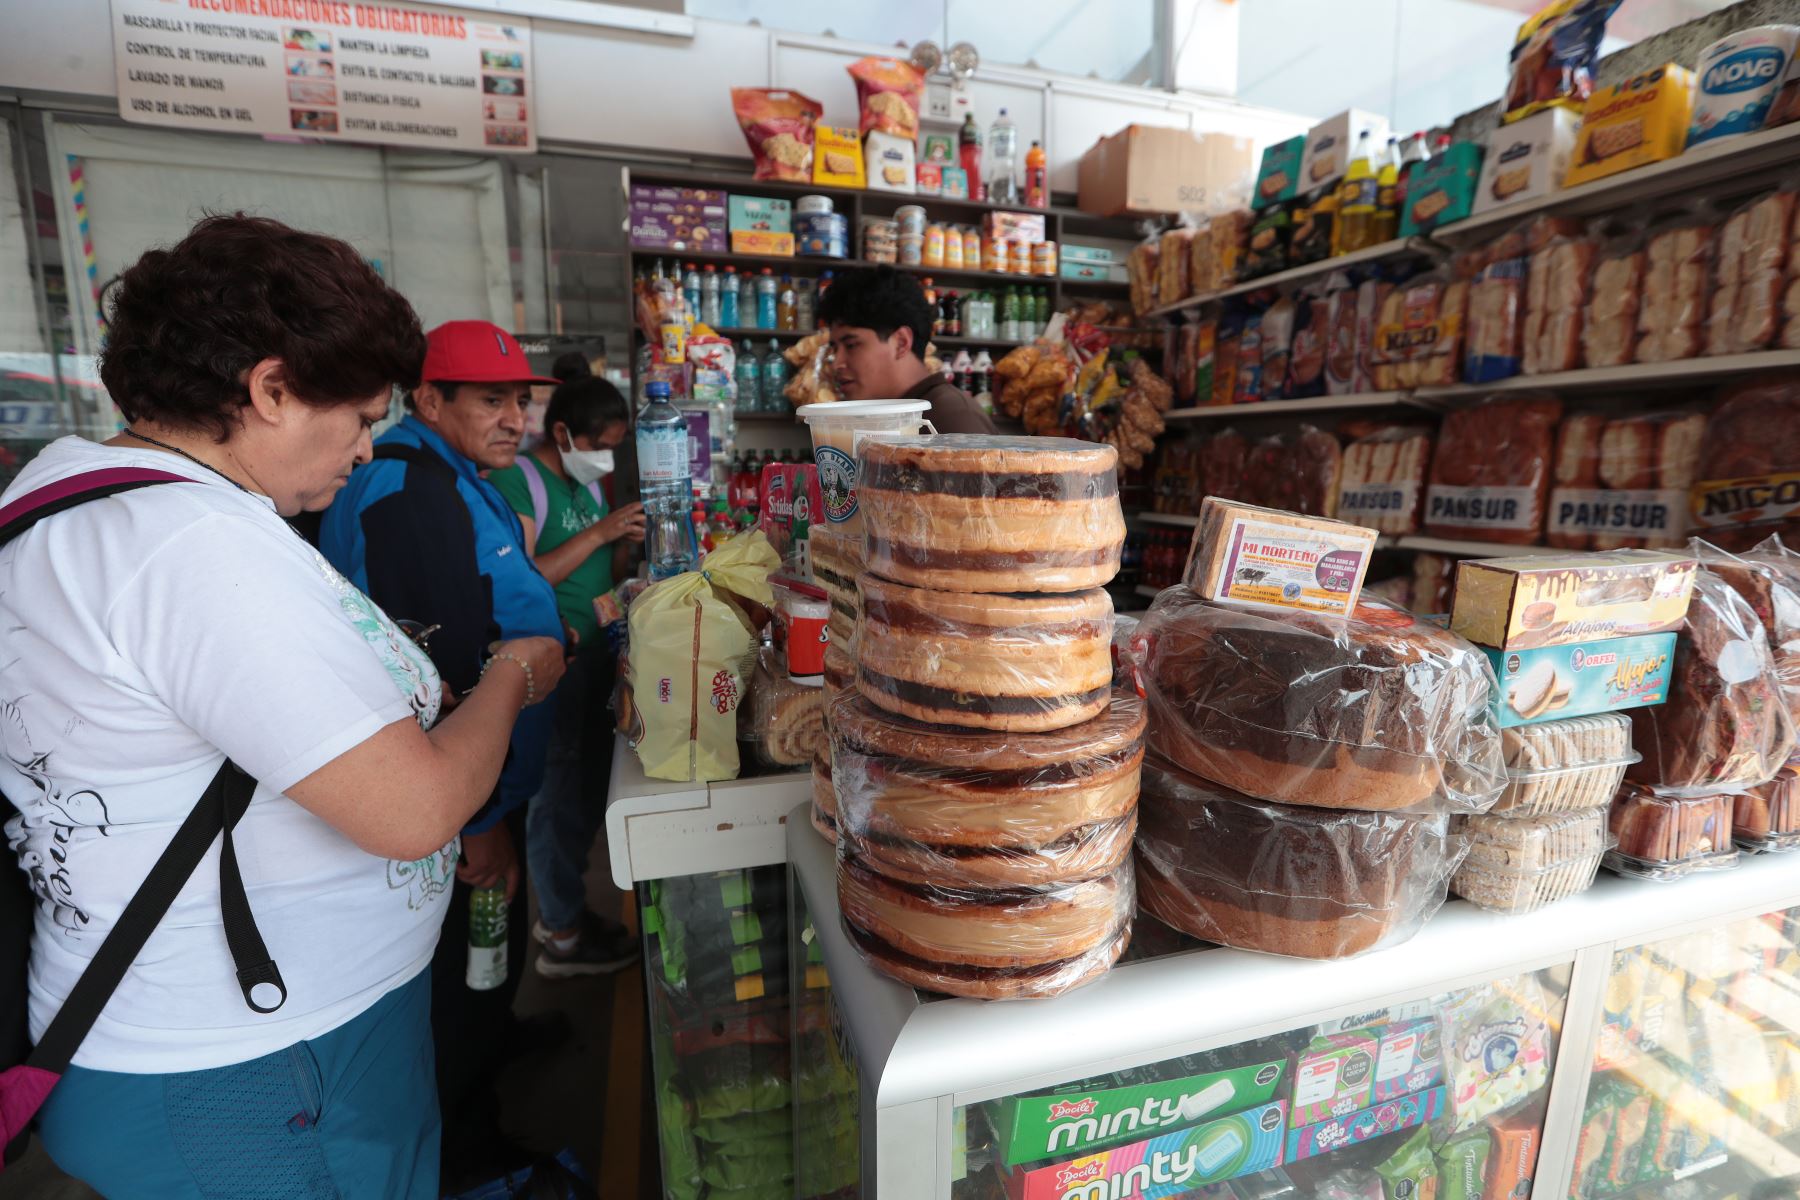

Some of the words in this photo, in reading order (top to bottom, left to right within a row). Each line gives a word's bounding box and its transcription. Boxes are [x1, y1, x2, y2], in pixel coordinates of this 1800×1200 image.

[123, 14, 183, 32] MASCARILLA
[185, 21, 191, 32] Y
[193, 21, 246, 38] PROTECTOR
[248, 27, 280, 43] FACIAL
[355, 3, 467, 40] OBLIGATORIAS
[126, 41, 175, 59] CONTROL
[178, 48, 192, 60] DE
[195, 49, 266, 68] TEMPERATURA
[376, 43, 389, 54] LA
[392, 43, 430, 59] LIMPIEZA
[128, 69, 171, 86] LAVADO
[172, 75, 186, 88] DE
[189, 76, 224, 91] MANOS
[341, 64, 366, 78] EVITA
[368, 68, 379, 79] EL
[381, 69, 426, 84] CONTACTO
[427, 73, 438, 85] AL
[439, 74, 477, 89] SALUDAR
[130, 98, 152, 112] USO
[156, 100, 169, 114] DE
[172, 102, 217, 120] ALCOHOL
[219, 107, 231, 120] EN
[234, 108, 254, 121] GEL
[343, 90, 390, 106] DISTANCIA
[380, 120, 458, 138] AGLOMERACIONES
[1343, 490, 1403, 510] PANSUR
[1430, 496, 1517, 521] PANSUR
[1702, 479, 1800, 516] NICO
[1558, 502, 1667, 530] PANSUR
[1242, 542, 1259, 554] MI
[1562, 619, 1617, 637] Alfajores
[1606, 655, 1667, 693] Alfajor
[660, 678, 671, 703] Unión
[1340, 1008, 1390, 1031] Chocman
[1056, 1101, 1091, 1116] Docile
[1046, 1093, 1189, 1153] minty
[1060, 1144, 1198, 1200] minty
[1063, 1165, 1099, 1184] Docile
